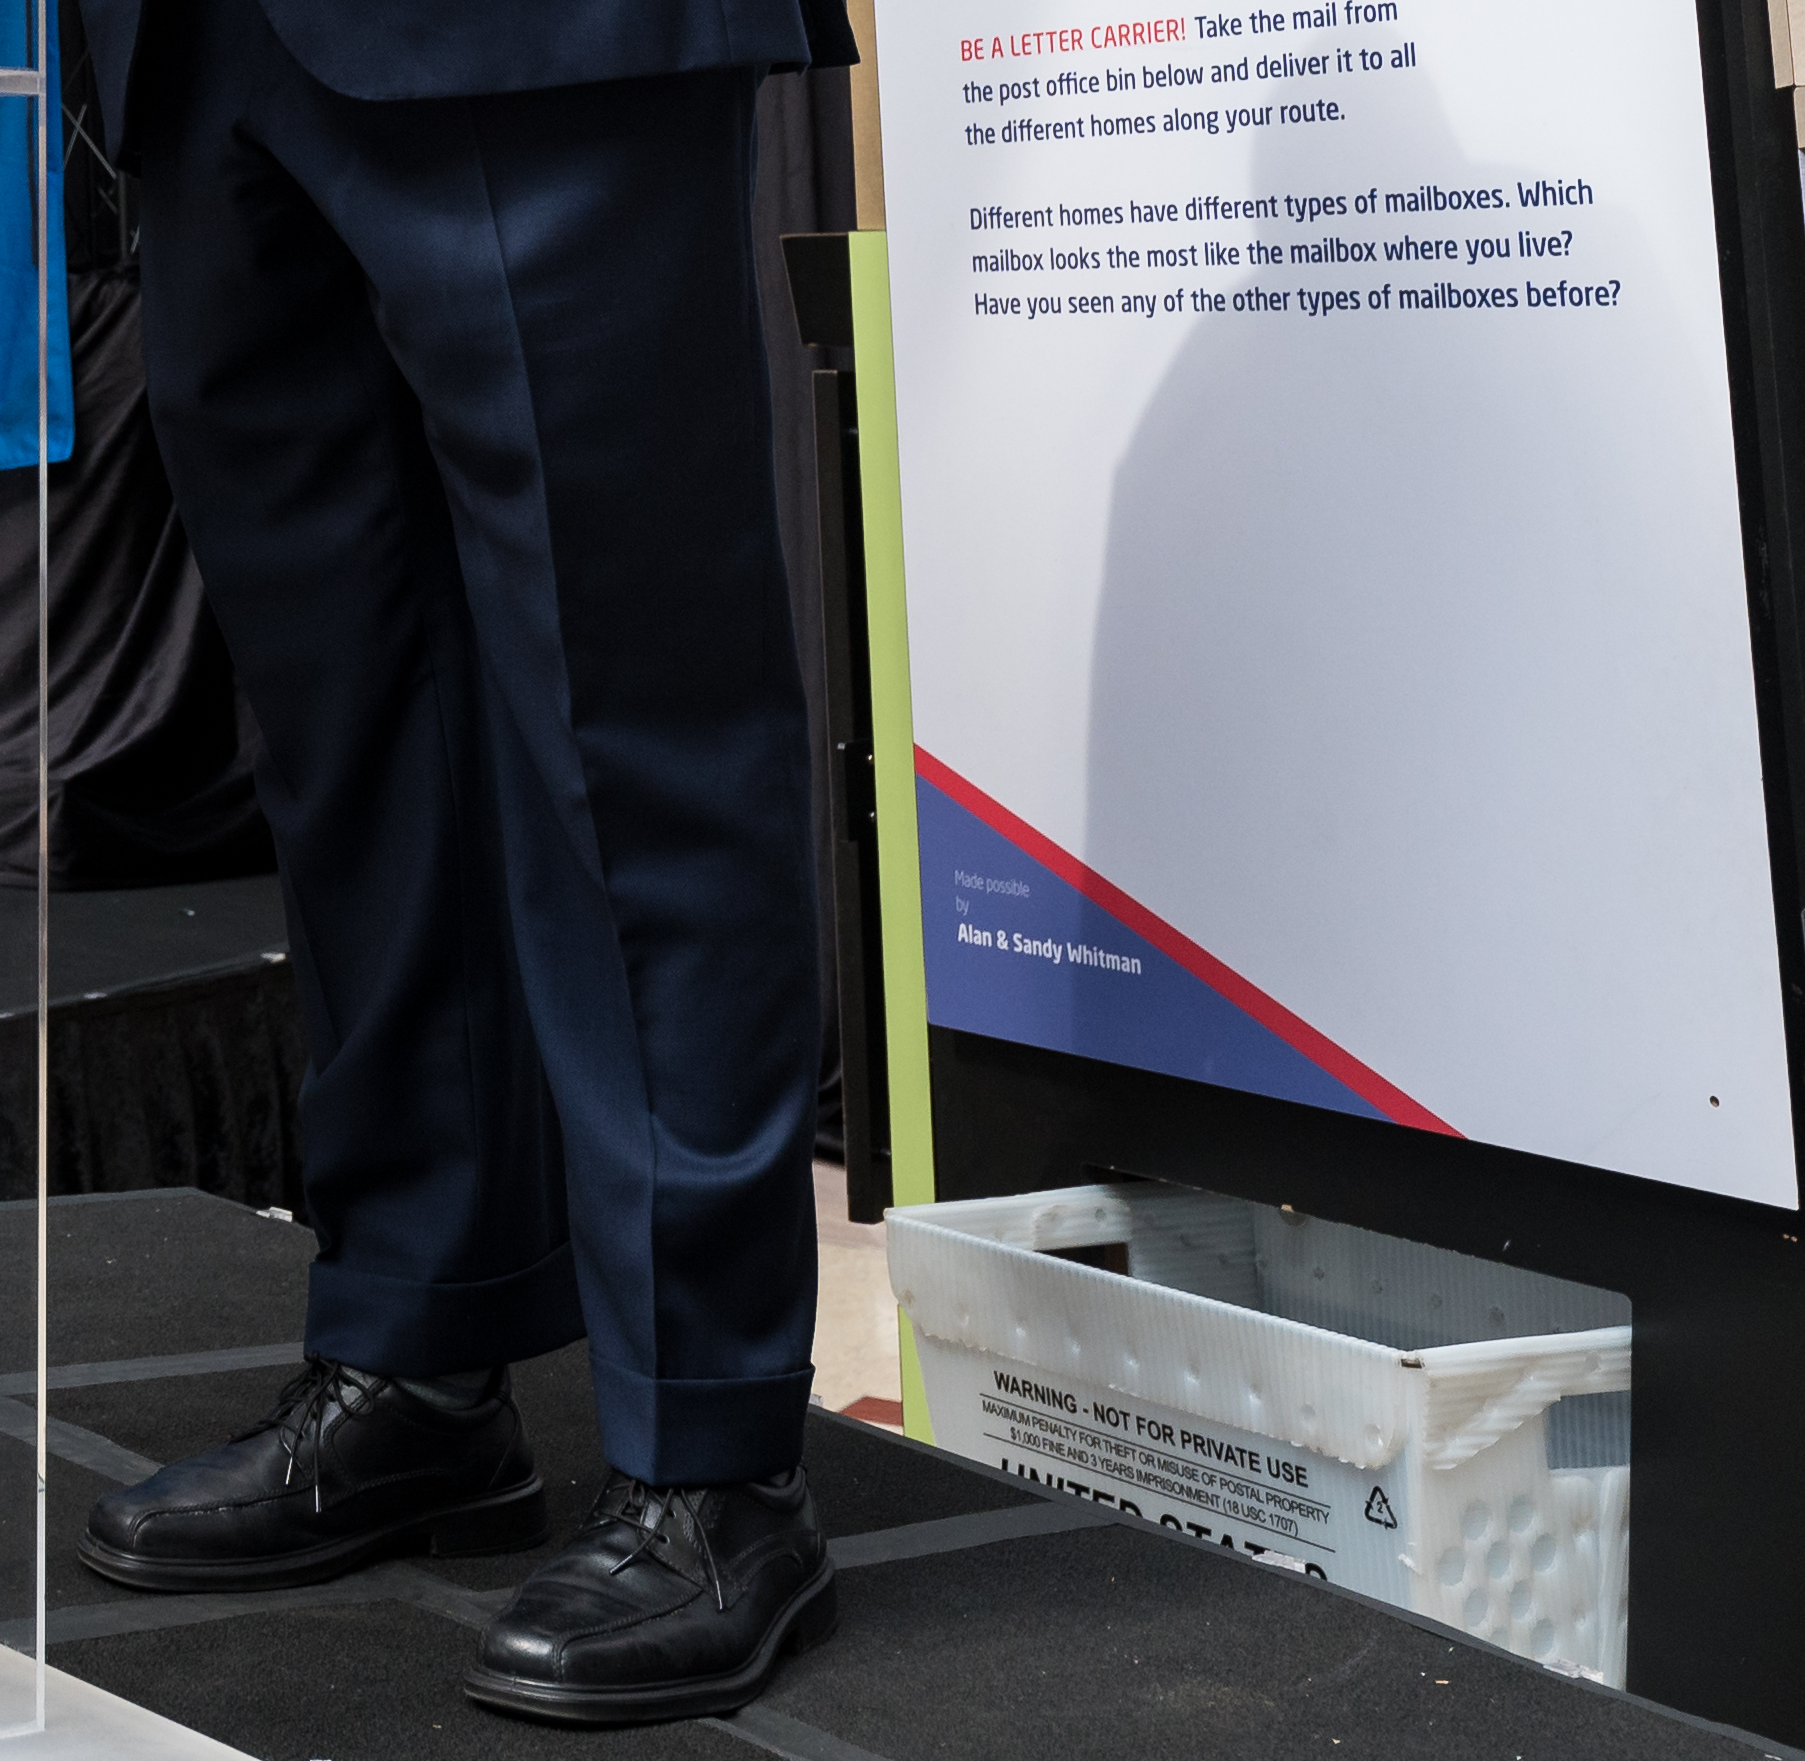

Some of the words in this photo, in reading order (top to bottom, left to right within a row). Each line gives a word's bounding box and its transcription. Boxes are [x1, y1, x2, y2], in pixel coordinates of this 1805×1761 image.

[960, 37, 985, 62] BE
[991, 36, 1004, 59] A
[1010, 28, 1084, 57] LETTER
[1090, 17, 1186, 49] CARRIER!
[1194, 13, 1243, 39] Take
[1249, 9, 1285, 34] the
[1292, 2, 1337, 30] mail
[1344, 0, 1398, 25] from
[962, 81, 994, 104] the
[999, 77, 1041, 107] post
[1046, 71, 1100, 97] office
[1106, 67, 1136, 92] bin
[1142, 63, 1203, 88] below
[1210, 56, 1249, 84] and
[1256, 52, 1330, 79] deliver
[1336, 48, 1354, 73] it
[1358, 48, 1383, 71] to
[1390, 42, 1417, 69] all
[964, 123, 996, 146] the
[1001, 117, 1085, 144] different
[1090, 114, 1156, 137] homes
[1163, 108, 1219, 135] along
[1225, 105, 1273, 134] your
[1279, 99, 1346, 125] route.
[969, 206, 1054, 230] Different
[1059, 204, 1124, 227] homes
[1130, 200, 1179, 224] have
[1185, 195, 1279, 221] different
[1284, 194, 1348, 223] types
[1354, 187, 1378, 214] of
[1385, 185, 1511, 213] mailboxes.
[1517, 178, 1594, 208] Which
[972, 248, 1044, 273] mailbox
[1050, 246, 1101, 271] looks
[1107, 245, 1140, 269] the
[1146, 244, 1198, 268] most
[1204, 241, 1240, 266] like
[1246, 240, 1283, 265] the
[1290, 237, 1377, 264] mailbox
[1383, 235, 1459, 261] where
[1465, 236, 1511, 265] you
[1518, 230, 1573, 258] live?
[975, 292, 1021, 315] Have
[1027, 295, 1062, 320] you
[1068, 295, 1115, 314] seen
[1121, 294, 1157, 318] any
[1163, 288, 1185, 313] of
[1190, 288, 1226, 312] the
[1232, 286, 1290, 312] other
[1297, 287, 1361, 317] types
[1367, 283, 1391, 310] of
[1399, 282, 1519, 309] mailboxes
[1526, 280, 1621, 308] before?
[954, 870, 984, 890] Made
[986, 878, 1030, 898] possible
[956, 896, 969, 916] by
[958, 923, 992, 947] Alan
[997, 929, 1009, 951] &
[1013, 933, 1063, 965] Sandy
[1067, 942, 1142, 975] Whitman
[993, 1370, 1078, 1414] WARNING
[1093, 1401, 1130, 1431] NOT
[1136, 1415, 1176, 1446] FOR
[1180, 1429, 1262, 1474] PRIVATE
[1266, 1456, 1309, 1488] USE
[982, 1399, 1031, 1427] MAXIMUM
[1032, 1416, 1078, 1441] PENALTY
[1079, 1431, 1102, 1451] FOR
[1103, 1439, 1137, 1462] THEFT
[1138, 1452, 1156, 1469] OR
[1157, 1456, 1200, 1483] MISUSE
[1201, 1474, 1217, 1488] OF
[1219, 1477, 1264, 1504] POSTAL
[1266, 1494, 1330, 1525] PROPERTY
[1042, 1438, 1065, 1457] FINE
[1066, 1446, 1089, 1464] AND
[1090, 1454, 1098, 1467] 3
[1098, 1457, 1134, 1480] YEARS
[1136, 1469, 1220, 1506] IMPRISONMENT
[1222, 1497, 1239, 1515] (18
[1238, 1502, 1267, 1524] USC
[1269, 1514, 1299, 1537] 1707)
